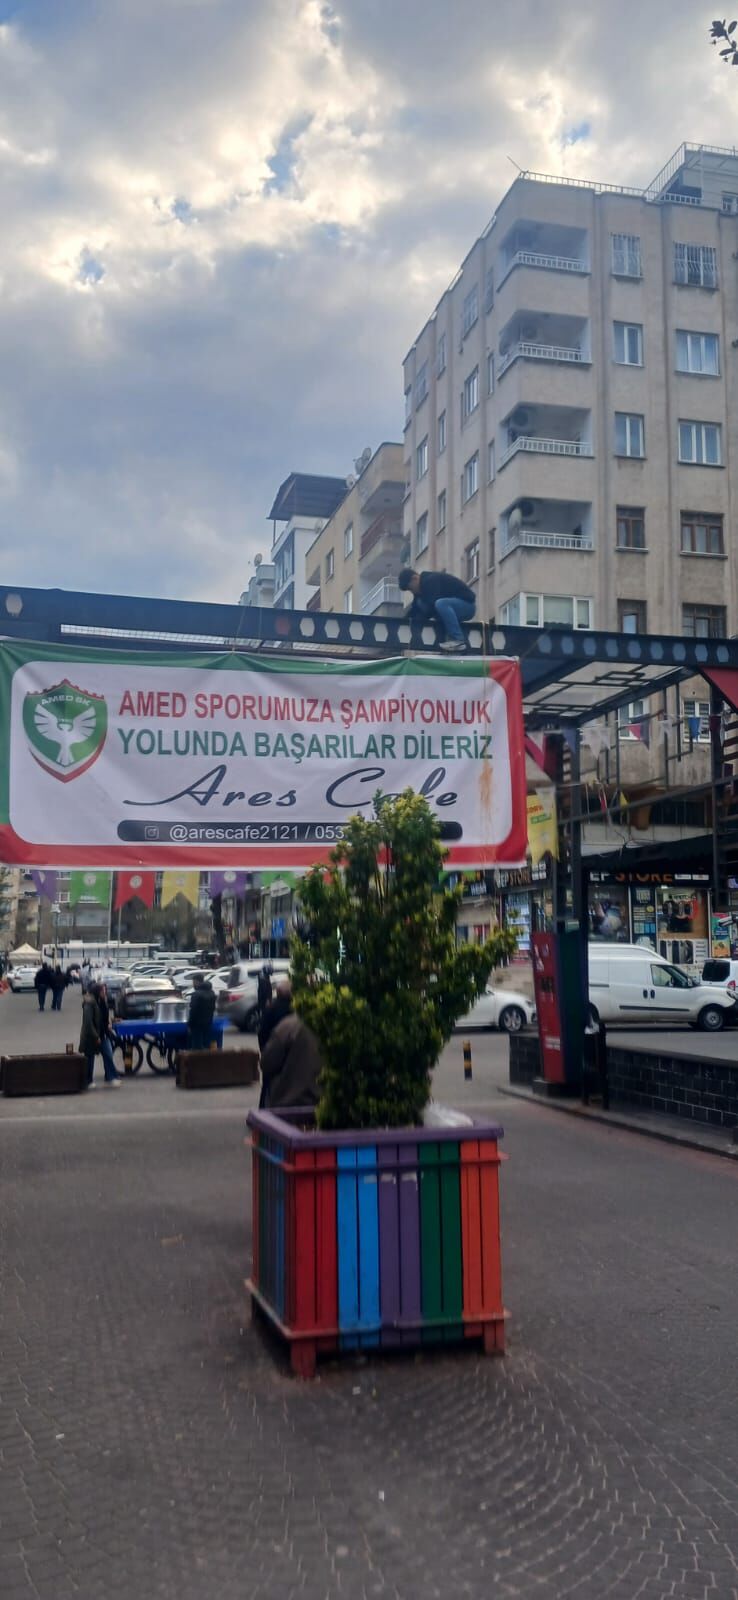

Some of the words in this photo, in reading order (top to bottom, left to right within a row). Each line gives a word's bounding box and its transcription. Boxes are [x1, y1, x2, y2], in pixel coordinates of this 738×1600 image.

[41, 694, 74, 705] AMED
[119, 690, 187, 718] AMED
[194, 693, 335, 723] SPORUMUZA
[340, 693, 492, 729] ŞAMPİYONLUK
[117, 728, 248, 757] YOLUNDA
[254, 732, 396, 764] BAŞARILAR
[403, 729, 493, 760] DİLERİZ
[122, 764, 297, 807] Ares
[169, 824, 299, 842] @arescafe2121
[304, 825, 310, 840] /
[314, 826, 345, 840] 053
